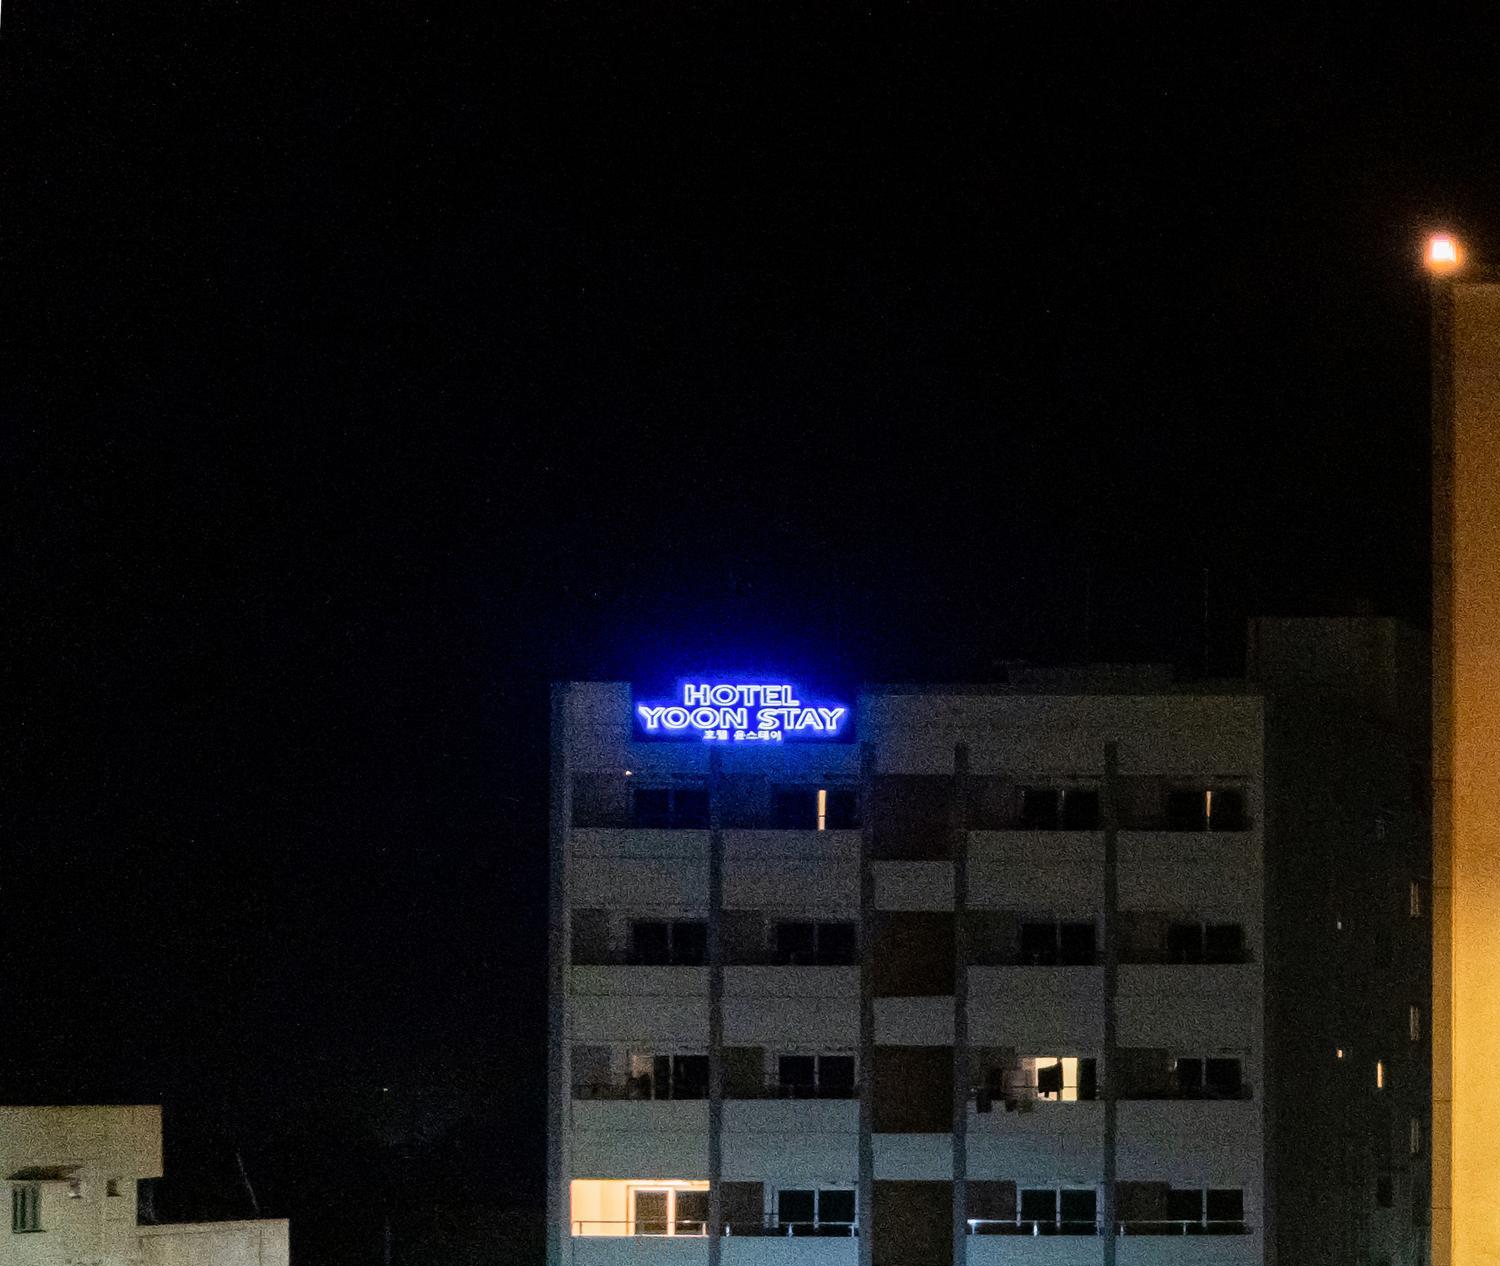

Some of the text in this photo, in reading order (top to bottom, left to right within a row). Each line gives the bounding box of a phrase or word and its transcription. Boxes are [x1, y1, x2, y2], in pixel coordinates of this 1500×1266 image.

[684, 684, 800, 706] HOTEL
[638, 706, 846, 730] YOON STAY
